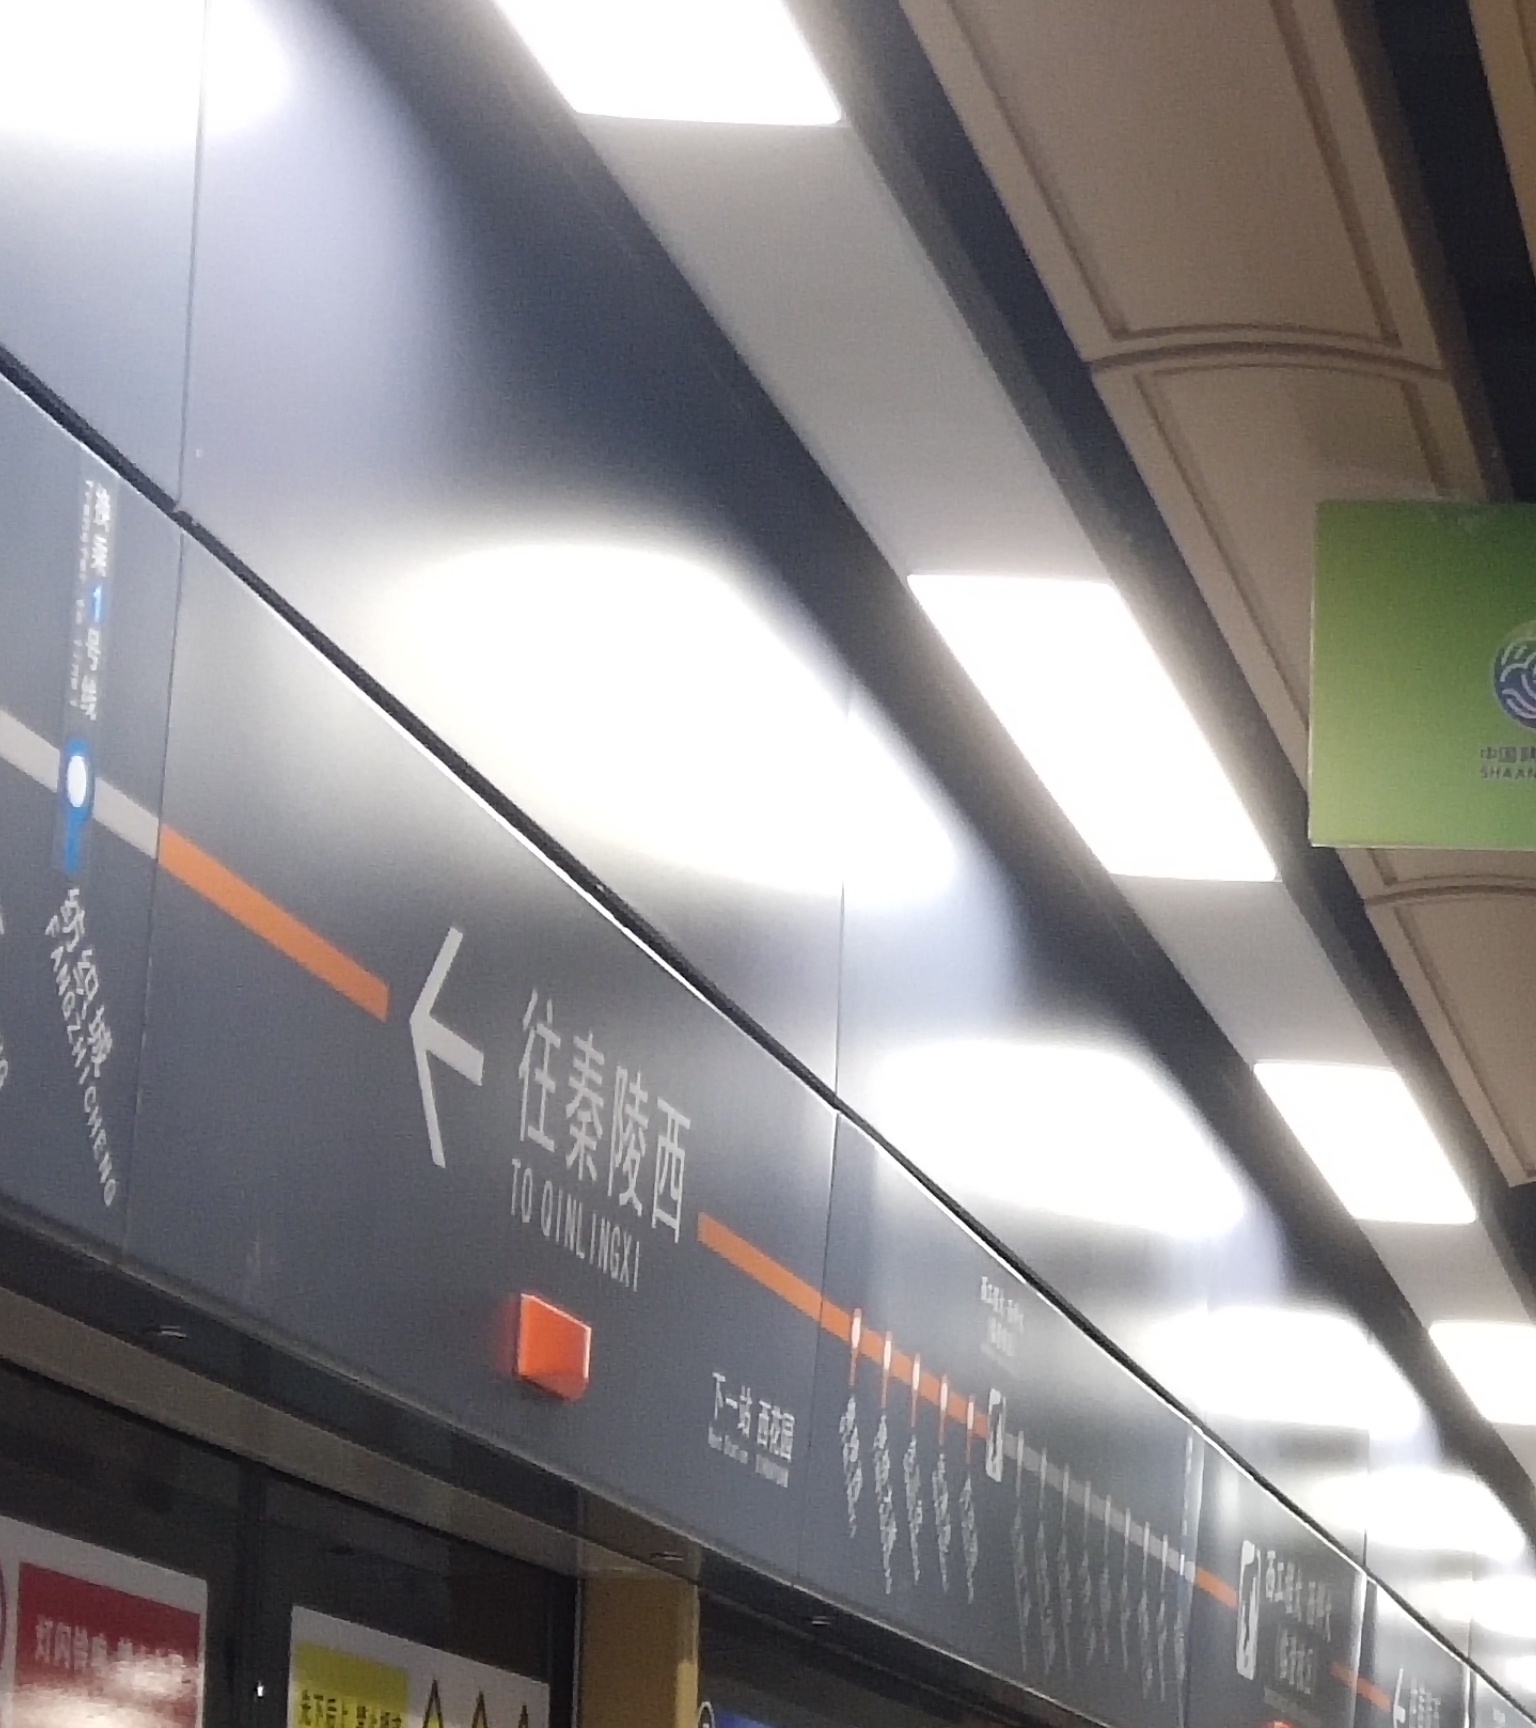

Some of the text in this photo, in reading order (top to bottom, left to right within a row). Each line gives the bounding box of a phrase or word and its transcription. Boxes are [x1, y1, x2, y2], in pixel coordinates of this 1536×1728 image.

[518, 986, 692, 1244] 往秦陵西
[510, 1158, 641, 1293] TO QINLINGXI
